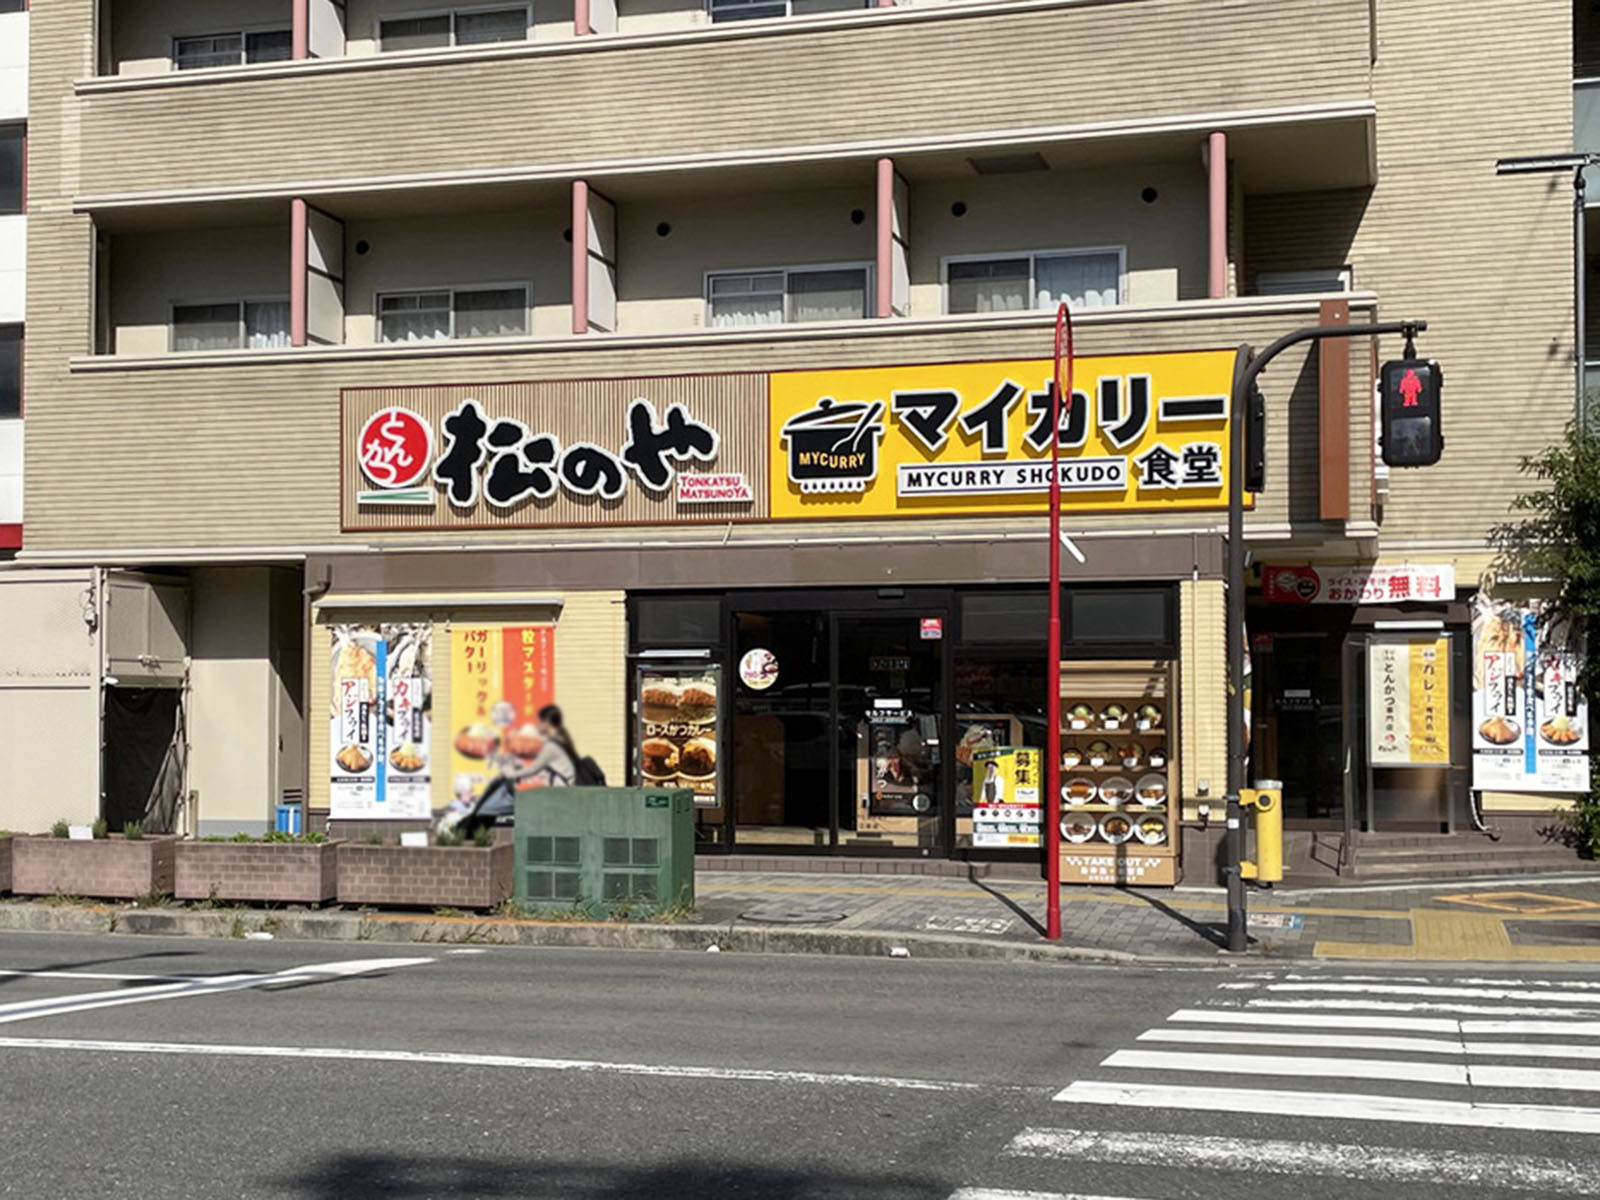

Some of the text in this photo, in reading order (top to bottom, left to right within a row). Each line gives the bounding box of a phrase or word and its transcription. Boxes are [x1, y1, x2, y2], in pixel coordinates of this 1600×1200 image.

[893, 375, 1228, 452] マイカリー
[362, 411, 414, 485] とんかつ
[435, 401, 715, 503] 松のや
[798, 450, 867, 469] MYCURRY
[1139, 445, 1220, 486] 食堂
[679, 486, 749, 500] MATSUNOYA
[680, 475, 741, 488] TONKATSU
[906, 465, 1121, 488] MYCURRY SHOKUDO
[1328, 587, 1384, 600] おかわり
[464, 630, 475, 673] バター
[1483, 655, 1503, 712] アジフライ
[341, 681, 359, 740] アジフライ
[1084, 857, 1114, 867] TAKE
